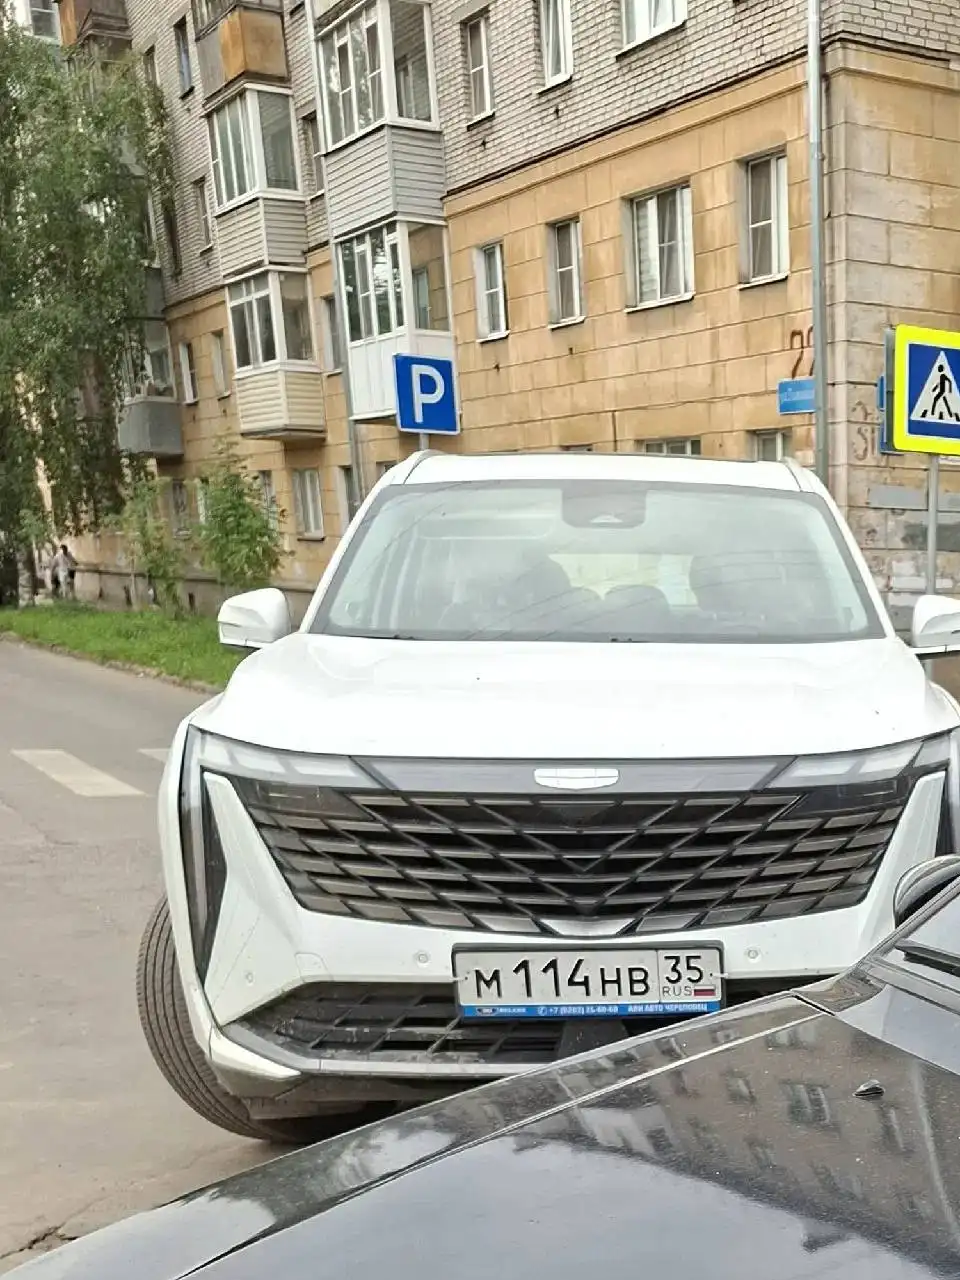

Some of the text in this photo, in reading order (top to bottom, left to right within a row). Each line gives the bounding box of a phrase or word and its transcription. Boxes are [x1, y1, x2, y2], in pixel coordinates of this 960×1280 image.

[411, 364, 445, 424] P
[663, 955, 703, 984] 35
[662, 985, 693, 998] RUS
